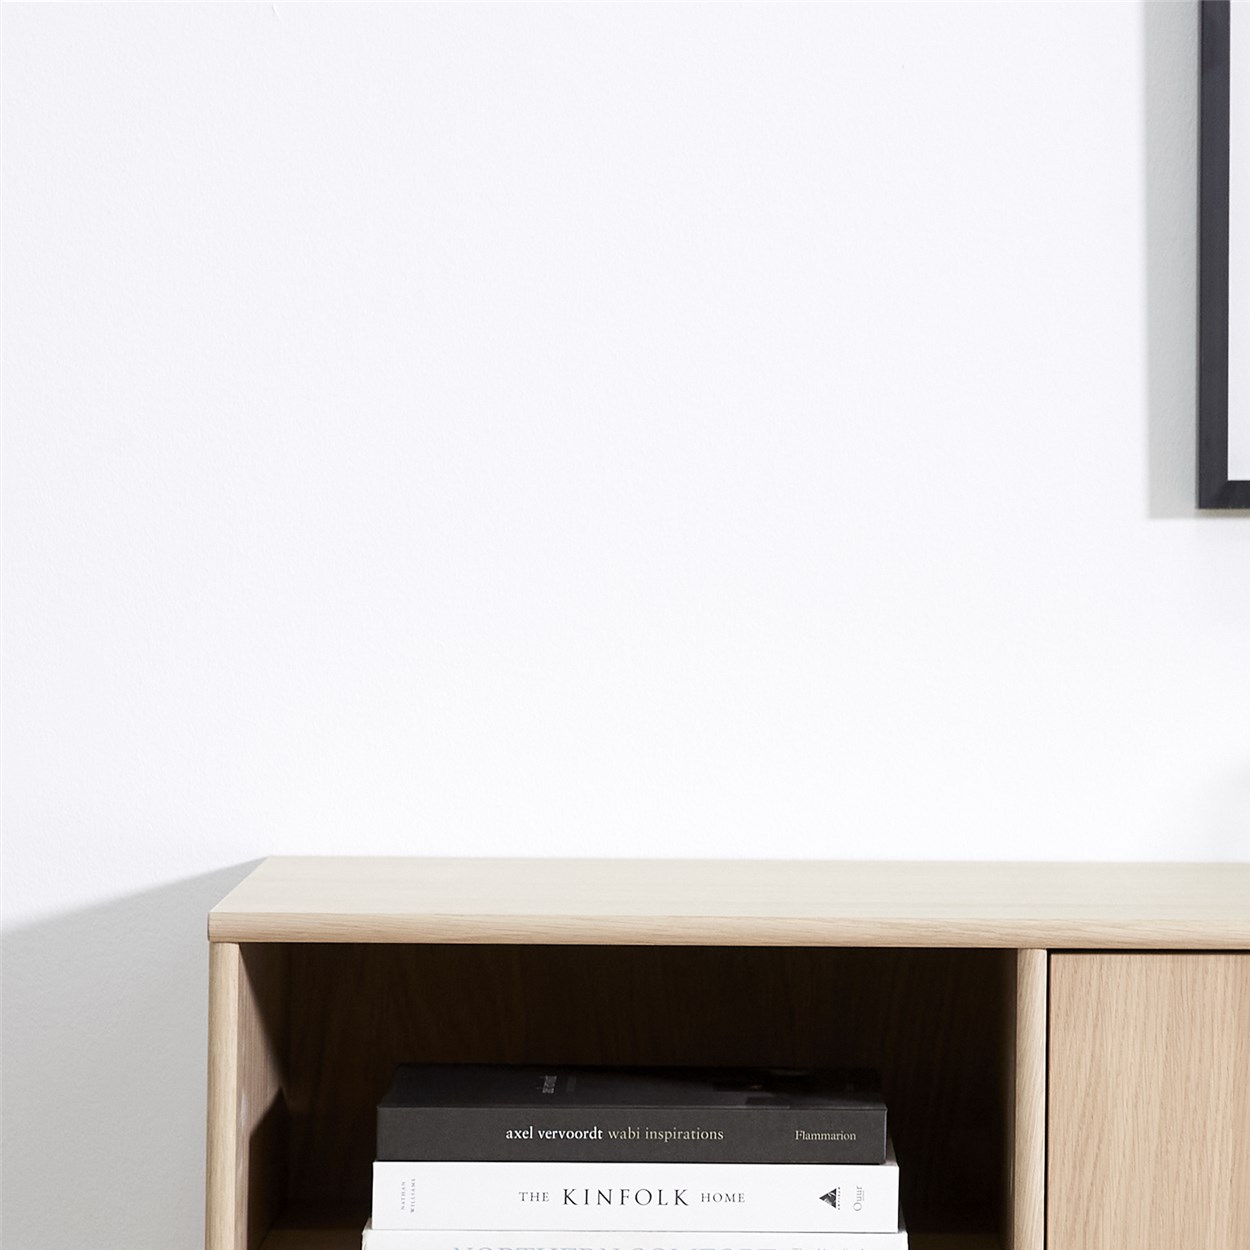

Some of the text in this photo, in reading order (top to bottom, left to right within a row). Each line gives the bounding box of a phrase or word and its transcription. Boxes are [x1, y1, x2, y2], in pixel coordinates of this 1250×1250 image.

[506, 1126, 723, 1142] axel vervoordt wabi inspirations
[795, 1130, 857, 1141] Flammarion
[518, 1188, 745, 1206] THE KINFOLK HOME
